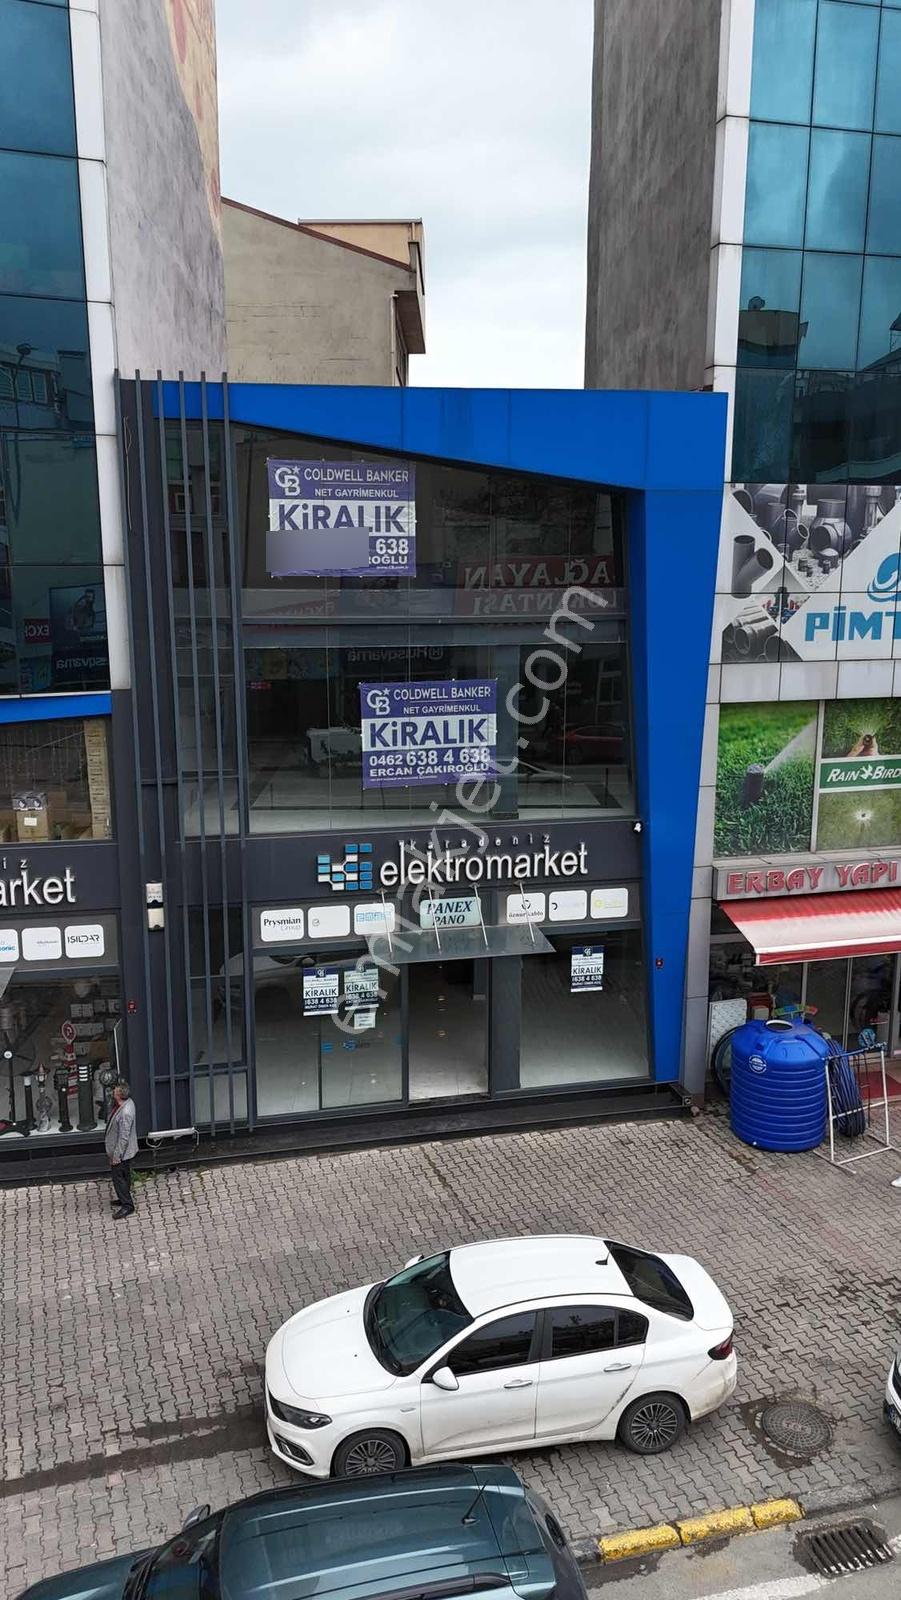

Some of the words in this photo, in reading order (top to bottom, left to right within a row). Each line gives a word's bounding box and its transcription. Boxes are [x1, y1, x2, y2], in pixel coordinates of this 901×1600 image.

[304, 468, 363, 482] COLDWELL
[366, 470, 409, 482] BANKER
[315, 488, 333, 497] NET
[335, 487, 399, 498] GAYRİMENKUL
[375, 538, 409, 555] 638
[393, 688, 448, 700] COLDWELL
[451, 686, 491, 698] BANKER
[403, 706, 420, 715] NET
[422, 704, 481, 714] GAYRİMENKUL
[369, 755, 403, 767] 0462
[406, 750, 438, 766] 638
[443, 749, 454, 764] 4
[459, 748, 491, 763] 638
[369, 767, 413, 777] ERCAN
[827, 768, 861, 782] RAIN
[380, 841, 589, 887] elektromarket
[727, 866, 825, 895] ERBAY
[835, 861, 899, 887] YAPI
[426, 900, 473, 915] PANEX
[263, 916, 301, 929] Prysmian
[432, 914, 466, 926] PANO
